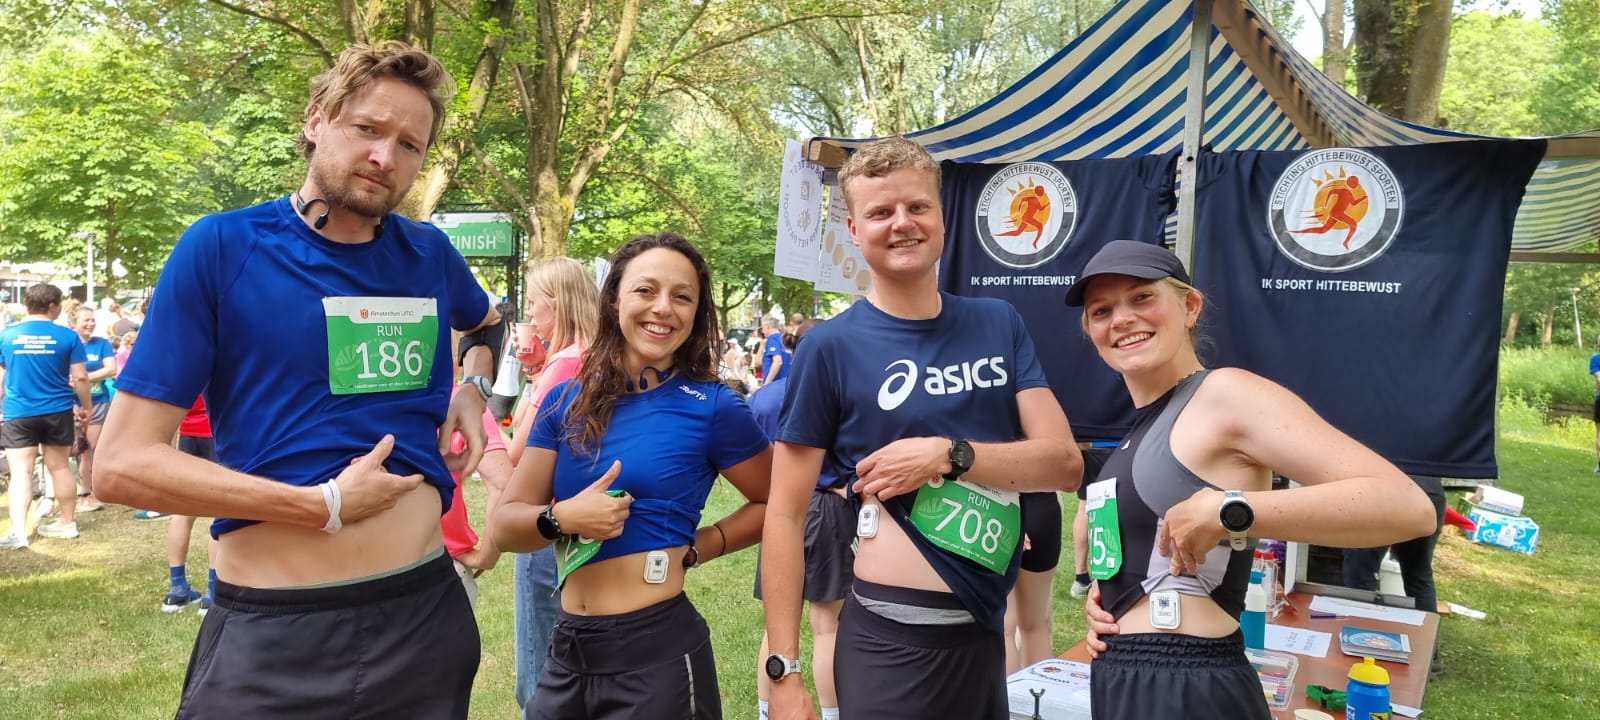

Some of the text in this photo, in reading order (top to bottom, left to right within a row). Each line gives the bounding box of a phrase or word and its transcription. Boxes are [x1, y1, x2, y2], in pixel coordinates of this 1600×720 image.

[1275, 151, 1397, 205] STICHTING HITTEBEWUST SPORTEN
[981, 164, 1073, 212] STICHTING HITTEBEWUST SPORTEN
[449, 235, 497, 250] FINISH
[971, 275, 1076, 286] IK SPORT HITTEBEWUST
[1262, 278, 1401, 293] IK SPORT HITTEBEWUST
[377, 325, 402, 336] RUN
[355, 340, 422, 379] 186
[967, 491, 990, 510] RUN
[935, 497, 1002, 554] 708
